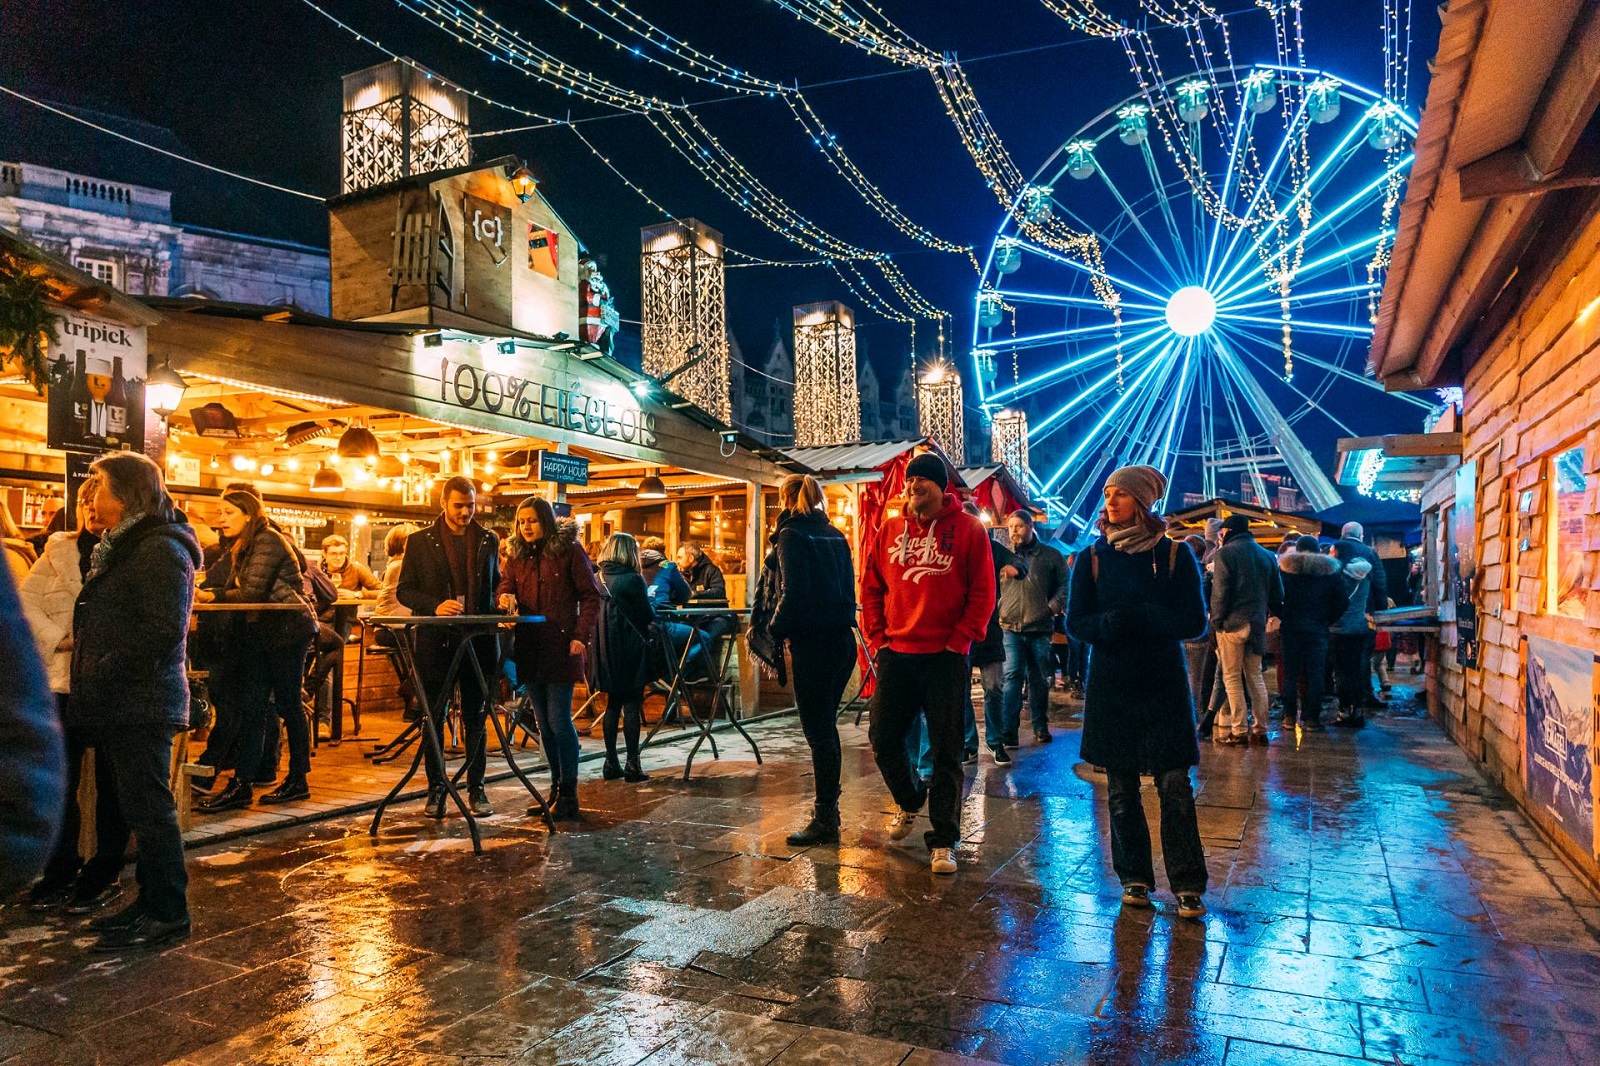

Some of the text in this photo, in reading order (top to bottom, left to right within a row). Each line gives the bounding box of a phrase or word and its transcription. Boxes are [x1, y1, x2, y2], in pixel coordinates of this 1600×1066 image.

[63, 321, 133, 347] tripick
[441, 357, 531, 418] 100%
[543, 461, 567, 474] HAPPY
[568, 466, 588, 479] HOUR
